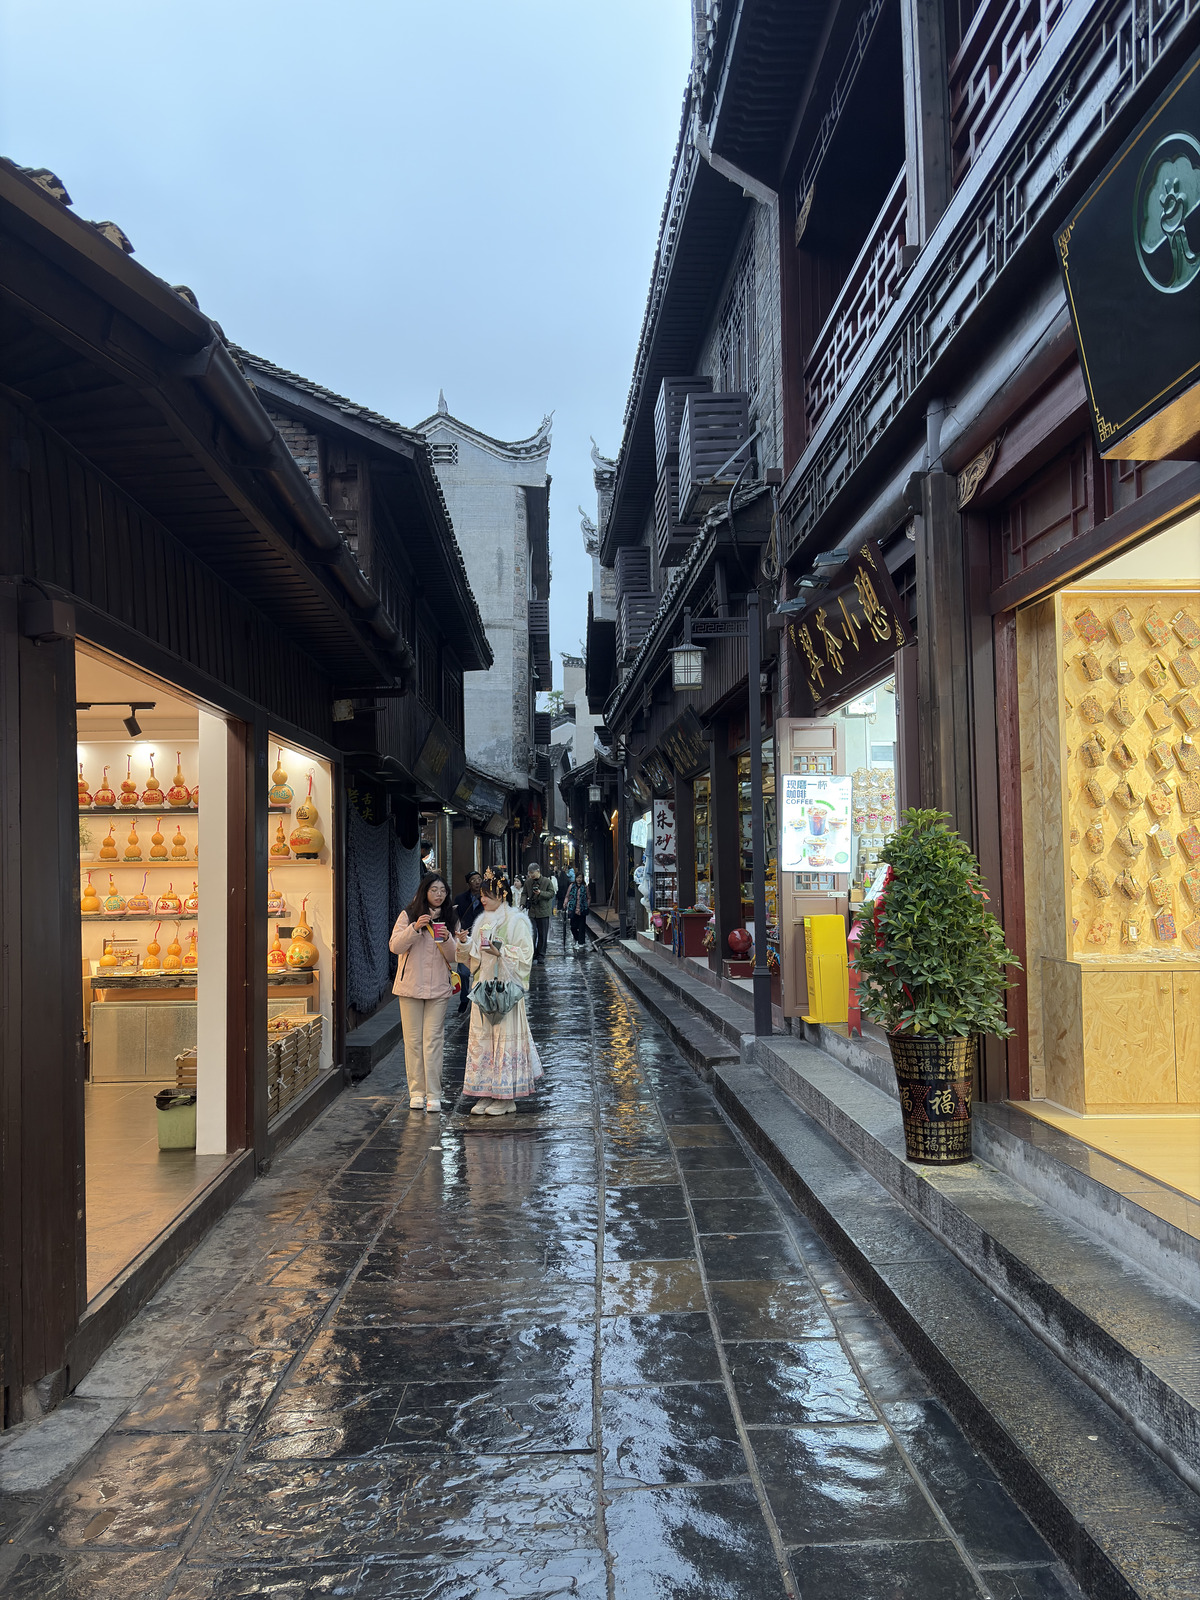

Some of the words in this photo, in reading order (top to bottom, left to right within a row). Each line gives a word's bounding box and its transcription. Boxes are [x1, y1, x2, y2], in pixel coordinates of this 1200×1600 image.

[786, 780, 828, 790] 现磨一杯
[786, 789, 807, 799] 咖啡
[655, 809, 674, 851] 朱砂
[919, 1058, 933, 1073] 福
[946, 1057, 959, 1072] 福
[928, 1088, 956, 1116] 福
